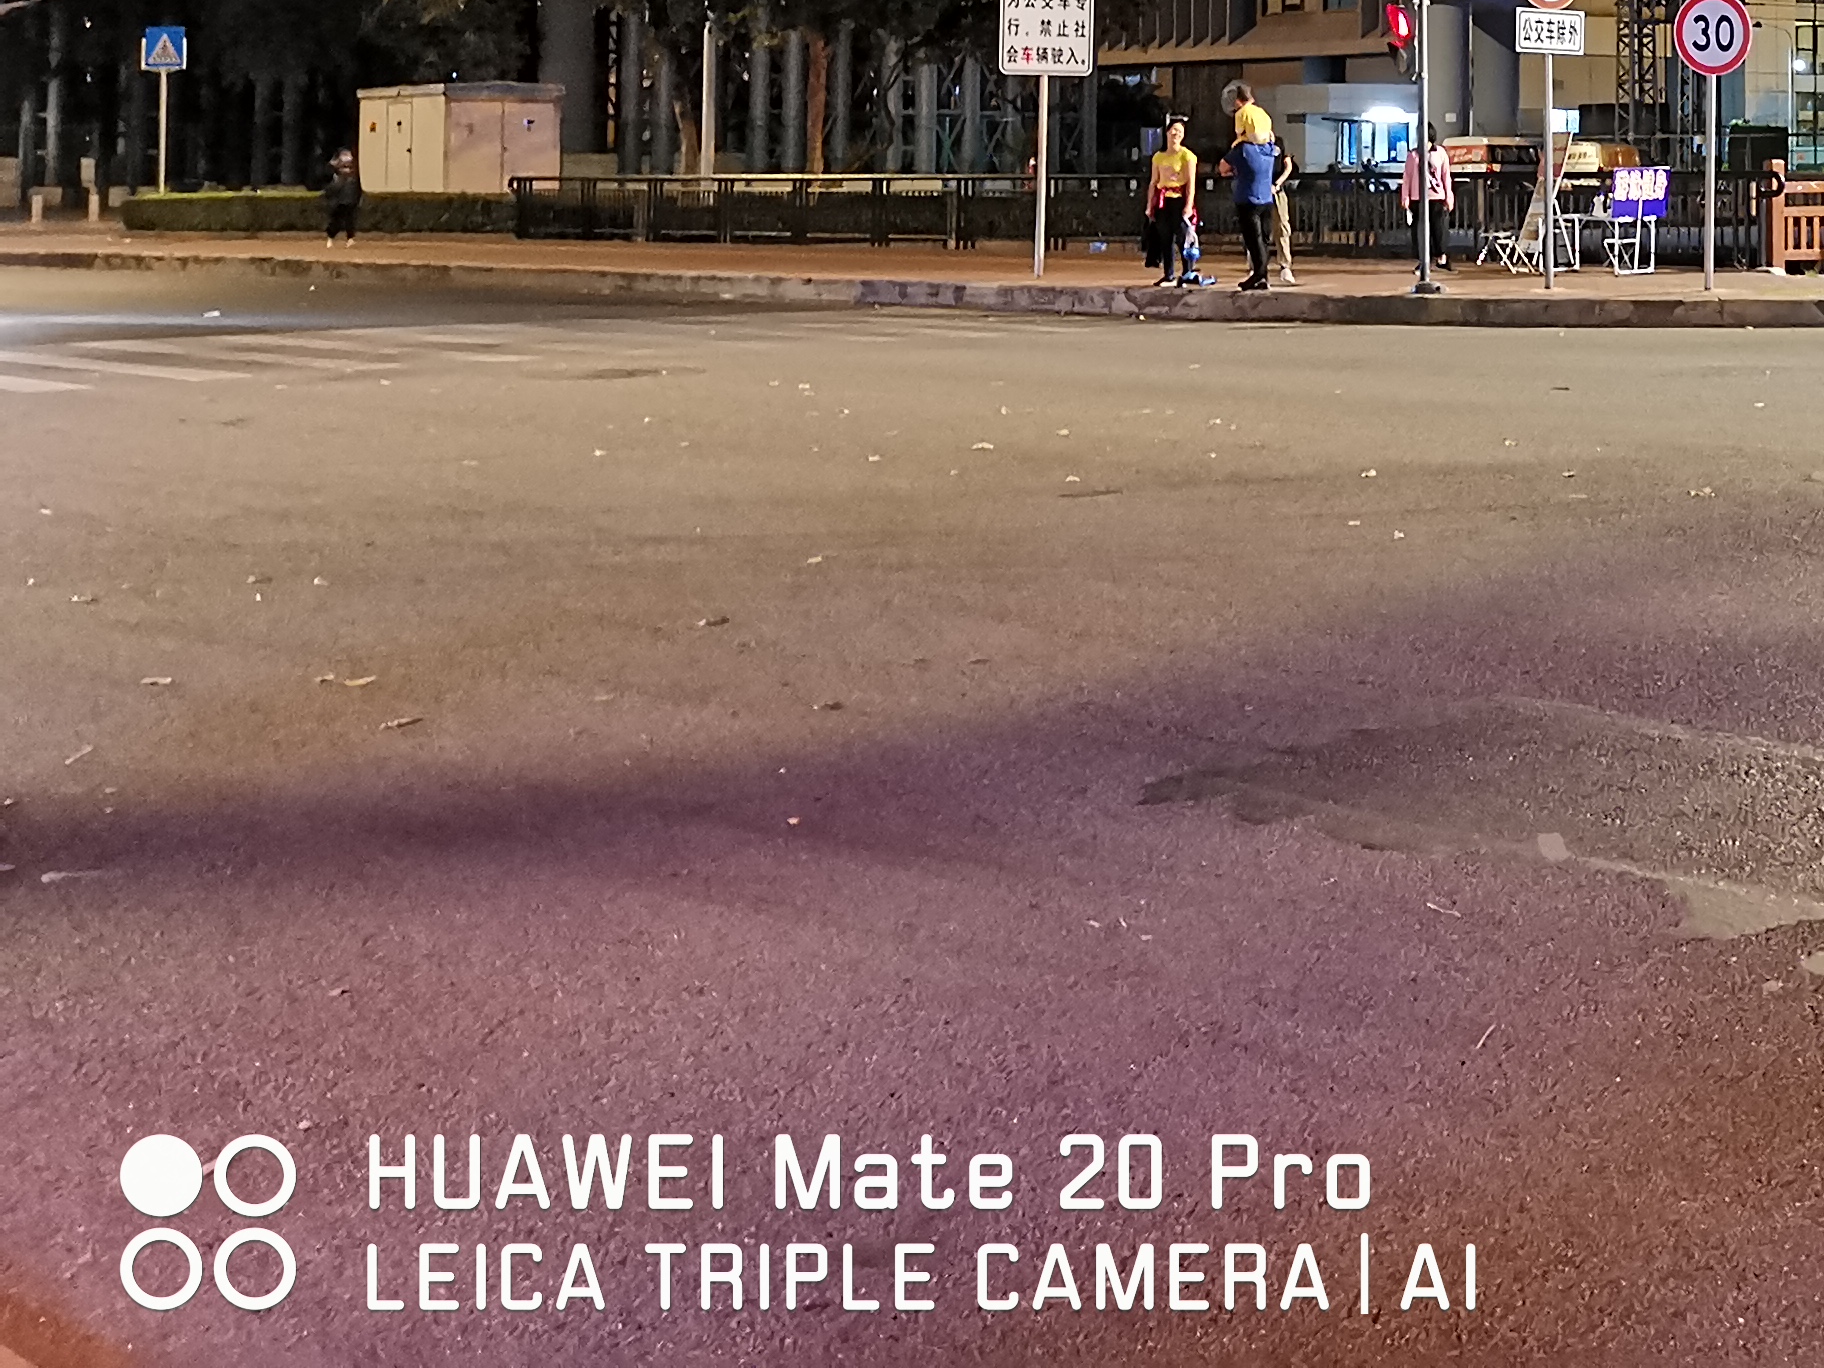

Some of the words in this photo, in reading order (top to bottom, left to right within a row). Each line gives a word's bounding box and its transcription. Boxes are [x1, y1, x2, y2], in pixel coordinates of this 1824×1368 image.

[1523, 17, 1578, 46] 公交车除外
[1692, 14, 1735, 52] 30
